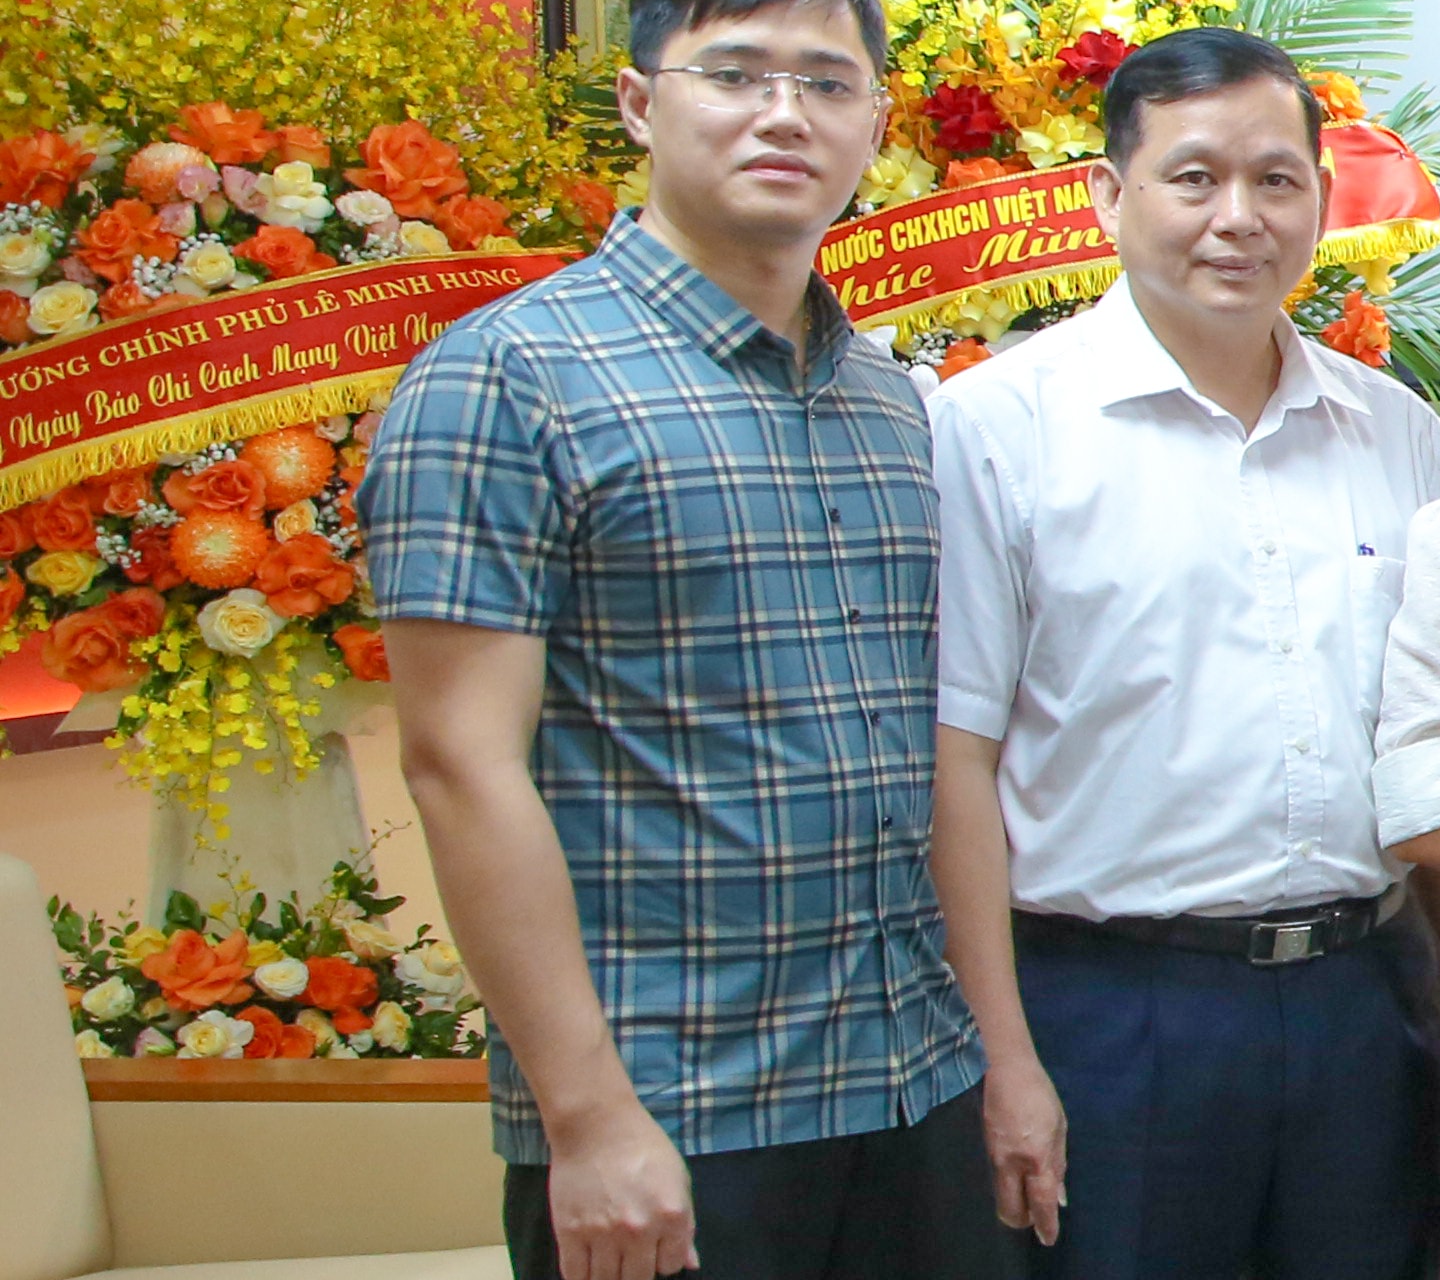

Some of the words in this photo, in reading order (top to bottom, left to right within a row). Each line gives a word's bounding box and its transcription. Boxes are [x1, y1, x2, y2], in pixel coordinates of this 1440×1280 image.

[820, 226, 885, 276] NƯỚC
[890, 198, 990, 249] CHXHCN
[993, 184, 1048, 228] VIỆT
[1053, 180, 1095, 215] NA
[829, 263, 936, 311] húc
[962, 225, 1119, 273] Mừn
[0, 355, 91, 399] ƯỚNG
[99, 320, 210, 367] CHÍNH
[215, 298, 288, 338] PHỦ
[294, 289, 341, 319] LÊ
[344, 274, 434, 307] MINH
[436, 268, 524, 290] HƯNG
[9, 409, 83, 449] Ngày
[199, 353, 261, 393] Cách
[267, 342, 341, 377] Mạng
[344, 322, 398, 358] Việt
